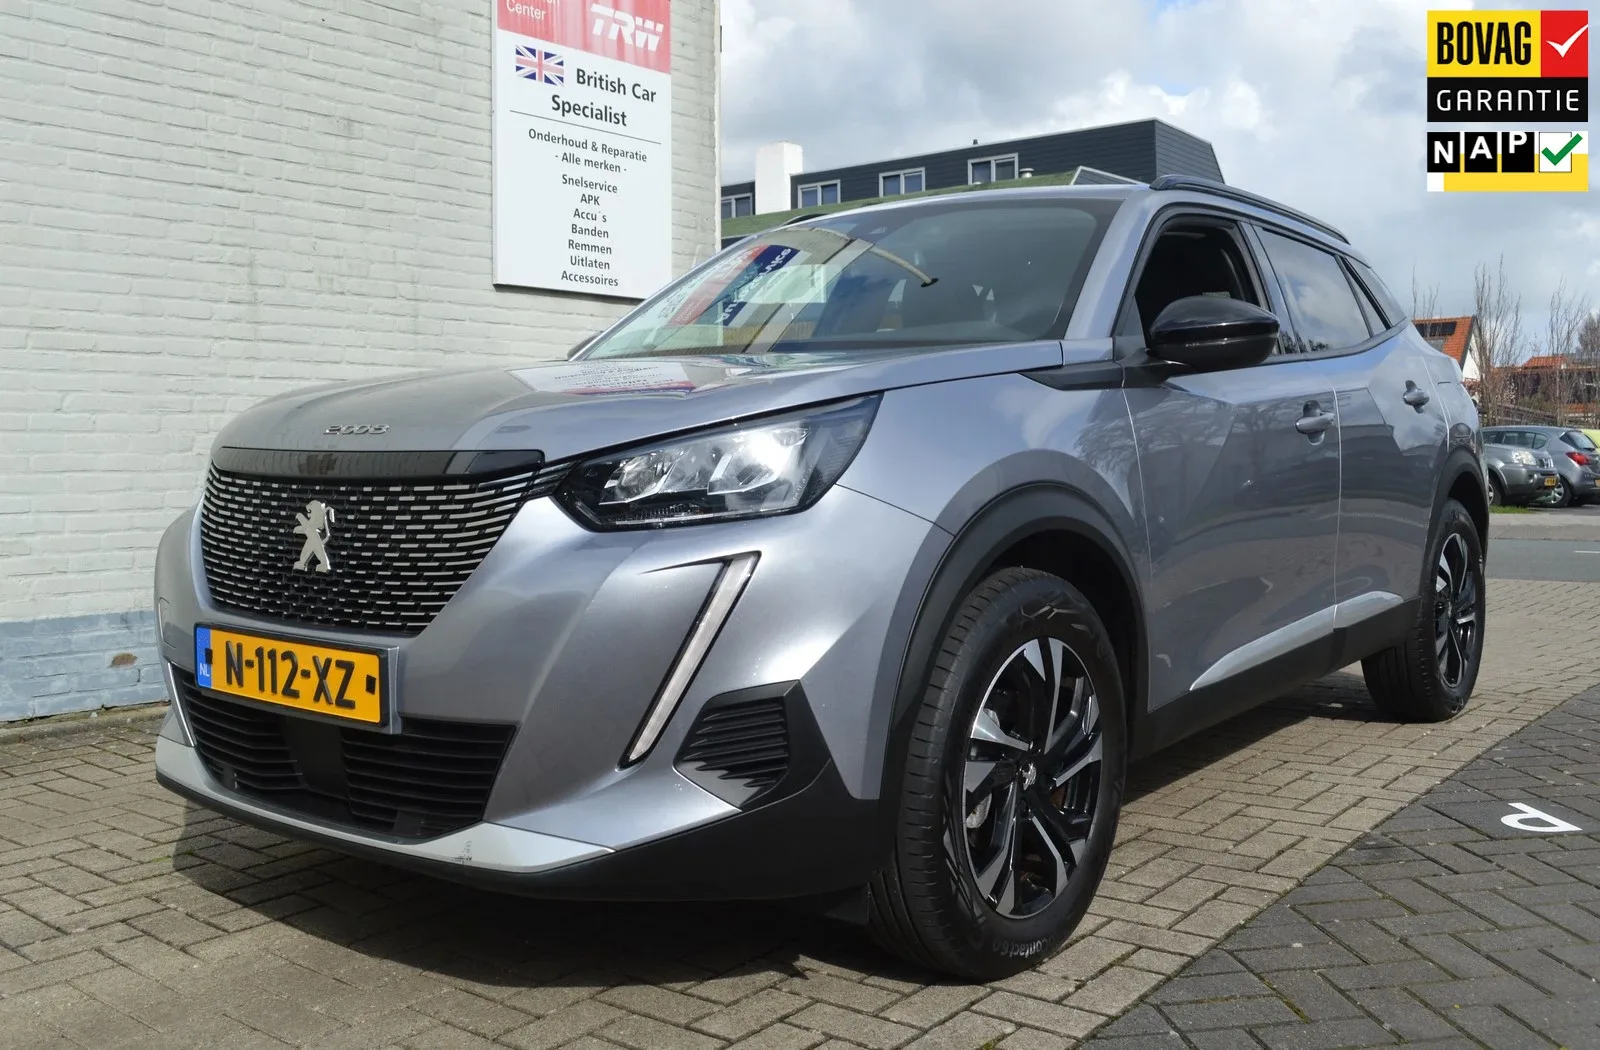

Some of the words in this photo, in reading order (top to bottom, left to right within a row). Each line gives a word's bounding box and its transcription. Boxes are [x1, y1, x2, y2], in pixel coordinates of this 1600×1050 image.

[506, 0, 546, 21] Center
[591, 3, 664, 52] TRW
[576, 68, 627, 96] British
[631, 83, 657, 103] Car
[551, 94, 627, 127] Specialist
[528, 128, 588, 151] Onderhoud
[591, 141, 599, 152] &
[601, 143, 648, 163] Reparatie
[561, 152, 581, 166] Alle
[584, 159, 621, 173] merken
[561, 173, 618, 194] Snelservice
[580, 193, 600, 206] APK
[571, 223, 609, 239] Banden
[568, 239, 612, 255] Remmen
[570, 255, 610, 270] Uitlaten
[561, 270, 619, 287] Accessoires
[323, 424, 390, 435] 2008
[199, 664, 210, 678] NL
[225, 640, 356, 710] N-112-XZ
